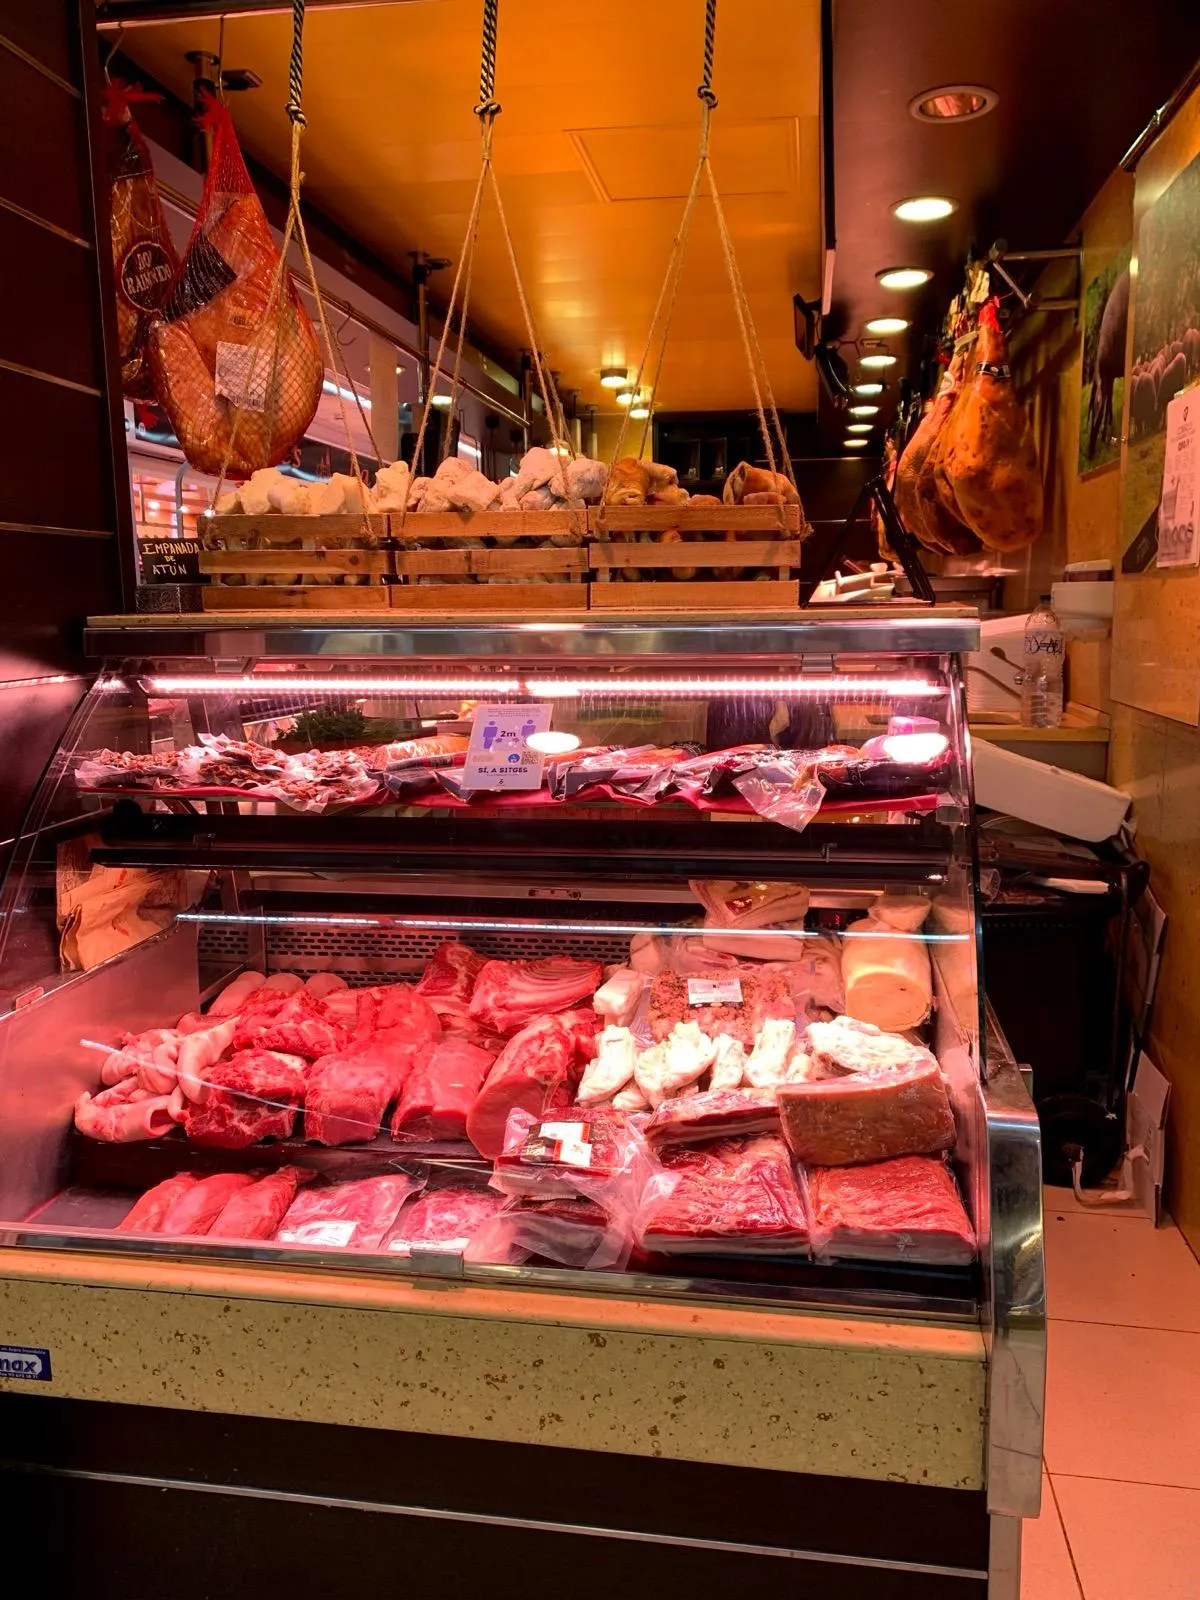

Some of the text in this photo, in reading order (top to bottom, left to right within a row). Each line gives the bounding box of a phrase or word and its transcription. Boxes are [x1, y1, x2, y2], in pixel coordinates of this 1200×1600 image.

[141, 542, 200, 555] EMPANADA
[500, 730, 517, 738] 2m
[499, 766, 529, 774] SITGES
